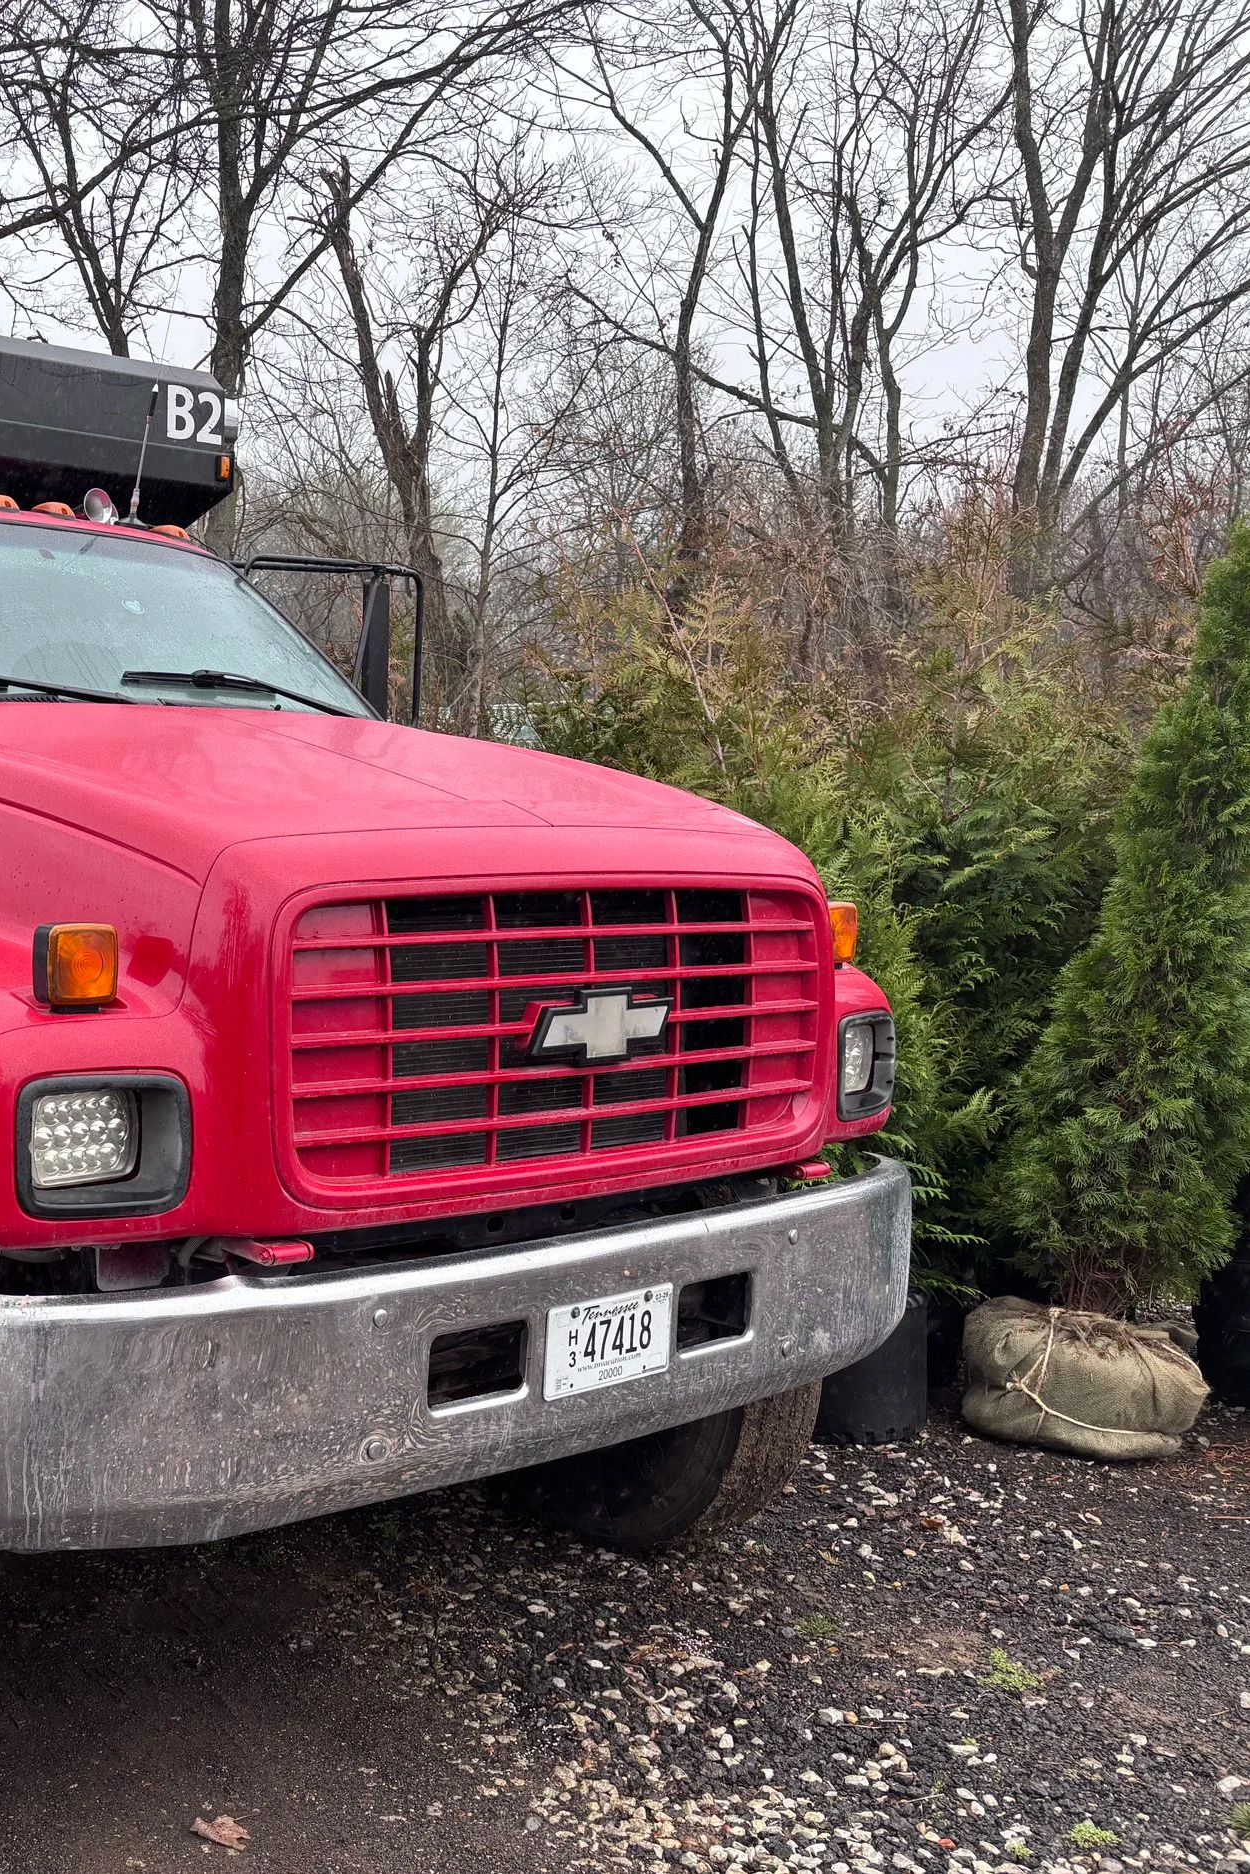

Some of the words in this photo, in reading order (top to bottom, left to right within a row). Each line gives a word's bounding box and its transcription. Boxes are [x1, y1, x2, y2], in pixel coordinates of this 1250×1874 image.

[166, 384, 223, 446] B2
[581, 1300, 640, 1326] Tennessee
[568, 1328, 579, 1347] H
[583, 1309, 652, 1363] 47418
[568, 1350, 577, 1368] 3
[598, 1365, 623, 1382] 20000
